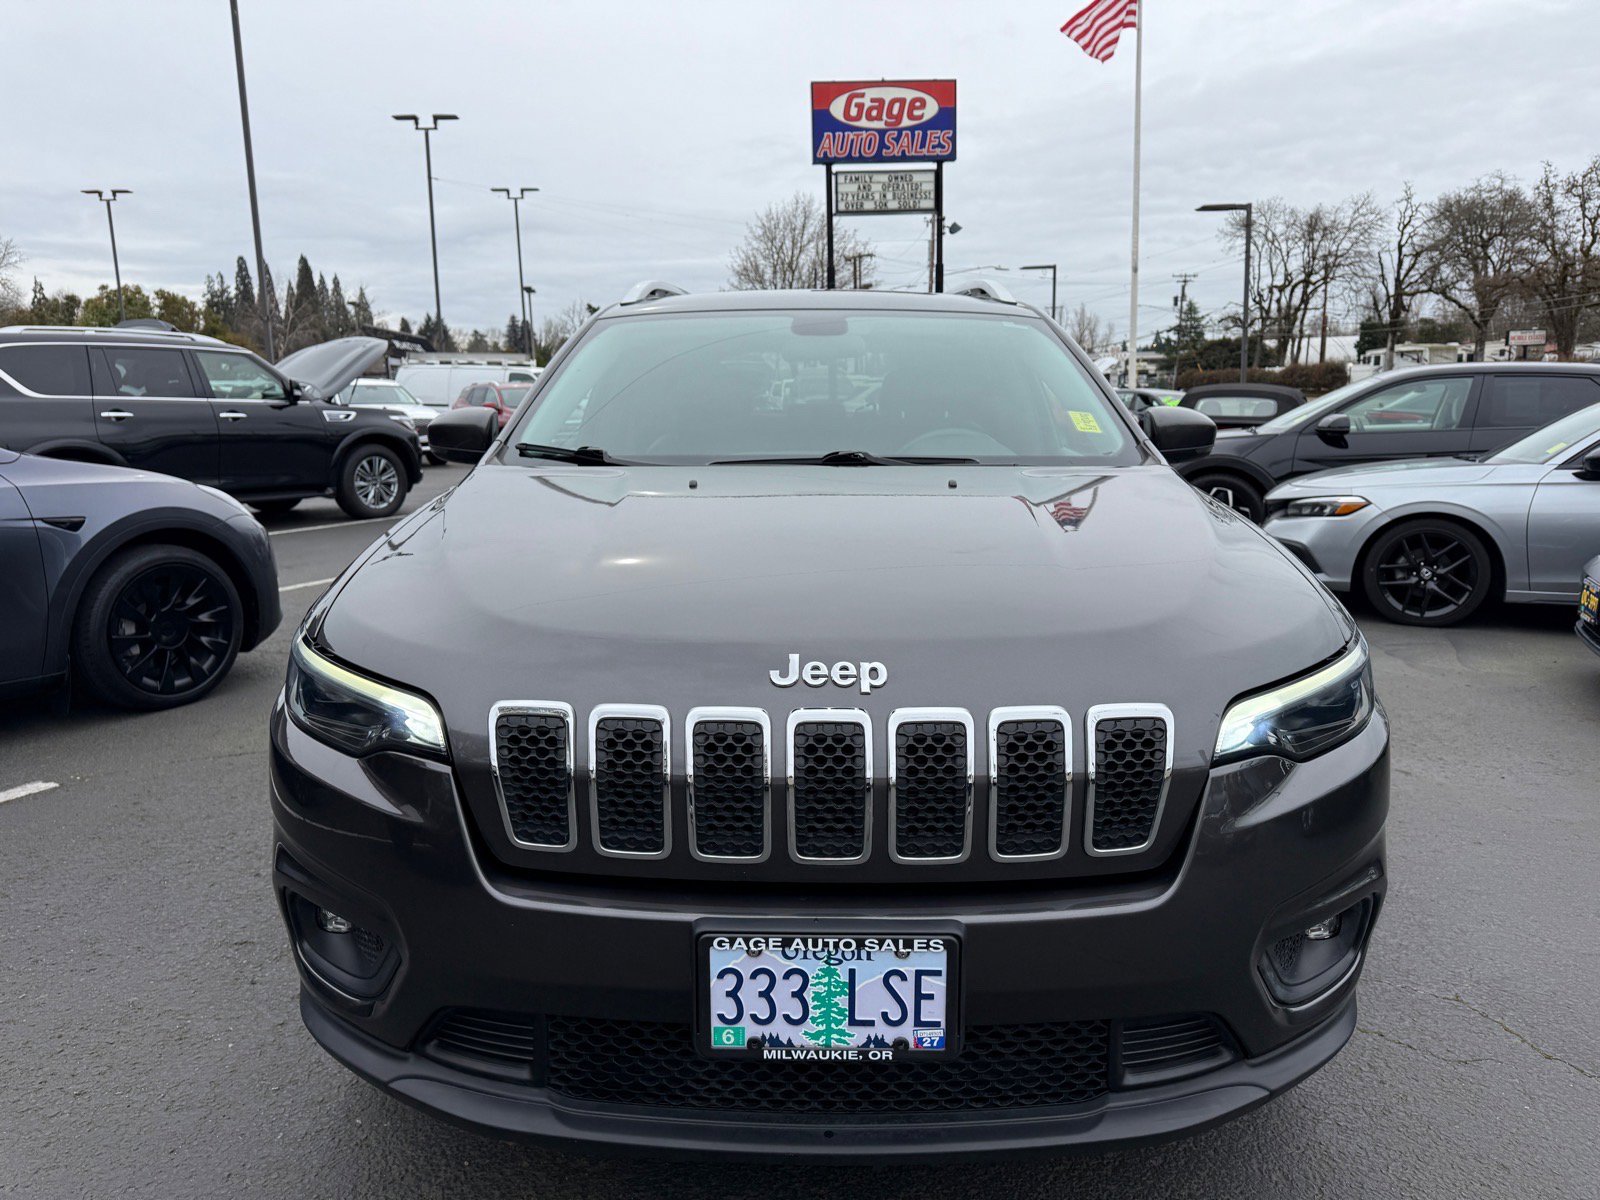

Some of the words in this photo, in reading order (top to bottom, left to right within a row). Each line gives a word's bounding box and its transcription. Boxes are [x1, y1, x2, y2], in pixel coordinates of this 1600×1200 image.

[843, 92, 927, 127] Gage
[816, 130, 879, 158] AUTO
[882, 129, 953, 156] SALES
[844, 174, 874, 183] FAMILY
[887, 174, 914, 182] OWNED
[857, 184, 872, 192] AND
[881, 183, 923, 192] OPERATED!
[851, 192, 875, 201] YEARS
[879, 192, 887, 200] IN
[892, 191, 931, 200] BUSINESS!
[844, 201, 865, 210] OVER
[897, 200, 921, 209] SOLD!
[769, 653, 888, 695] Jeep
[712, 937, 783, 951] GAGE
[787, 938, 857, 952] AUTO
[864, 938, 945, 952] SALES
[716, 967, 810, 1026] 333
[847, 968, 943, 1028] LSE
[721, 1030, 735, 1045] 6
[922, 1037, 940, 1048] 27
[763, 1049, 863, 1061] MILWAUKIE,
[868, 1050, 893, 1061] OR
